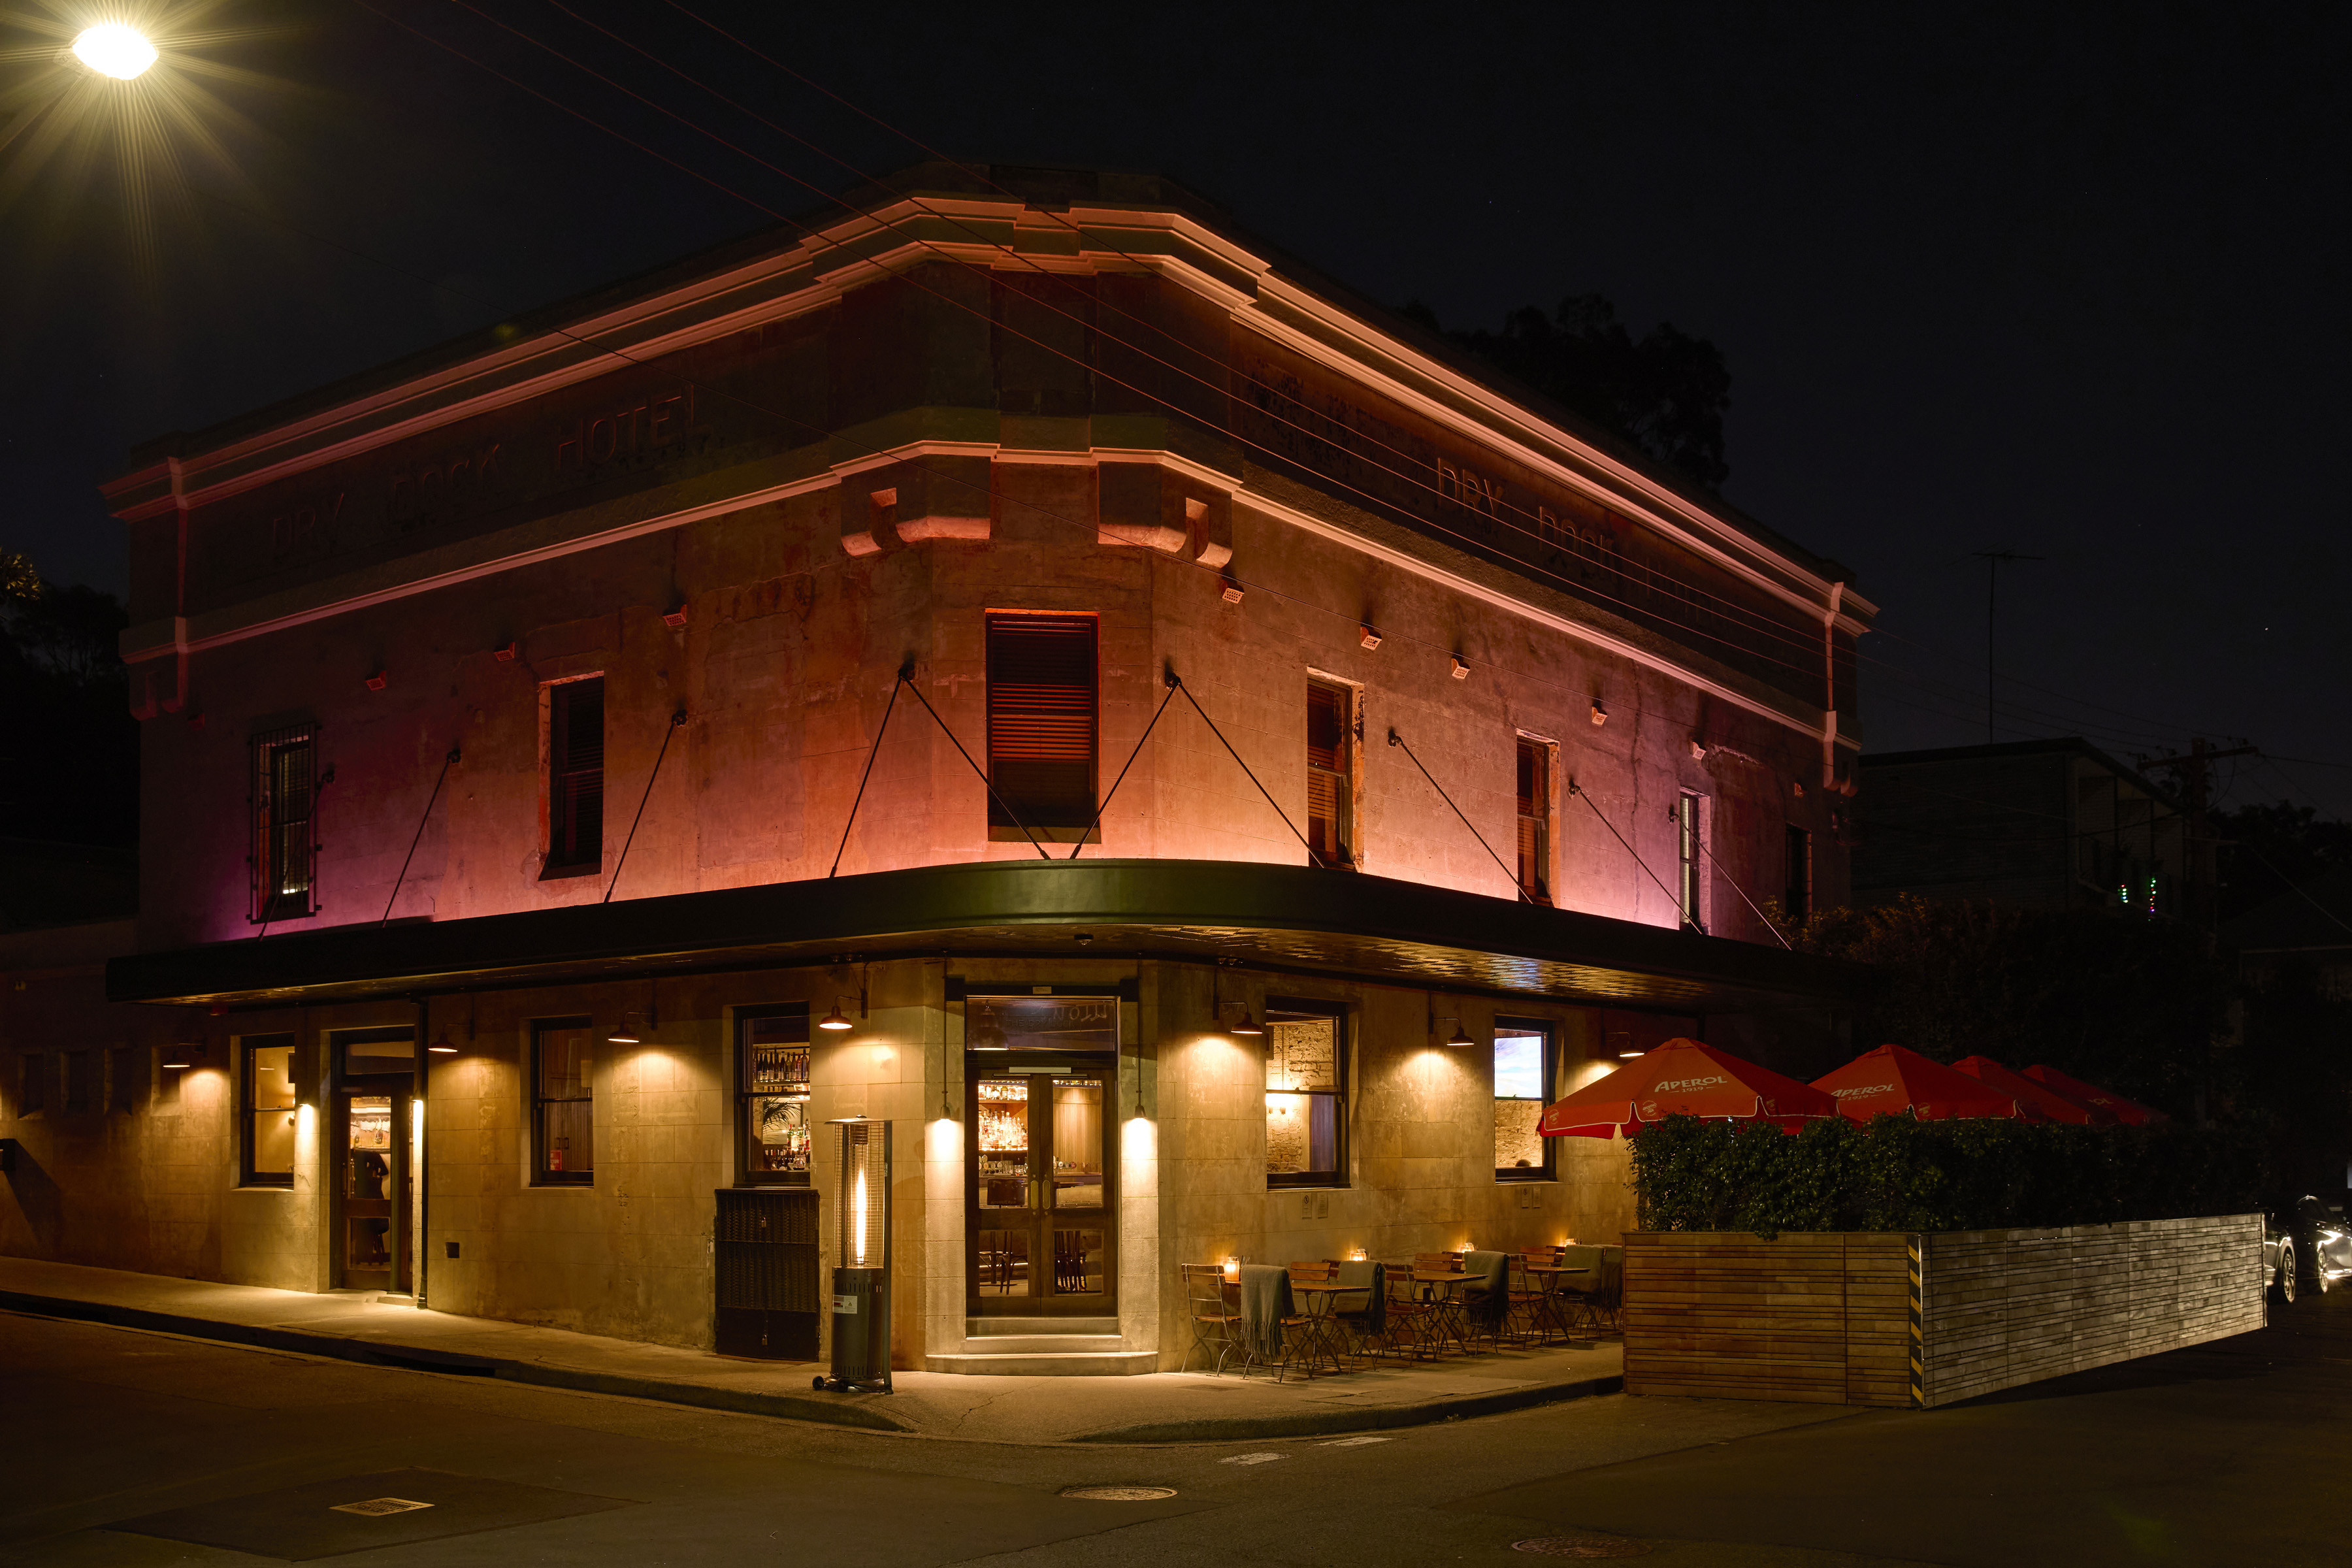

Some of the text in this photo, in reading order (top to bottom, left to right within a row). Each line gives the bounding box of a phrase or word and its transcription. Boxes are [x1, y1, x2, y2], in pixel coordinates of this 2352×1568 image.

[557, 384, 714, 471] HOTEL
[1437, 457, 1504, 521] DRY
[1654, 1075, 1727, 1092] APEROL
[1831, 1083, 1895, 1098] APEROL
